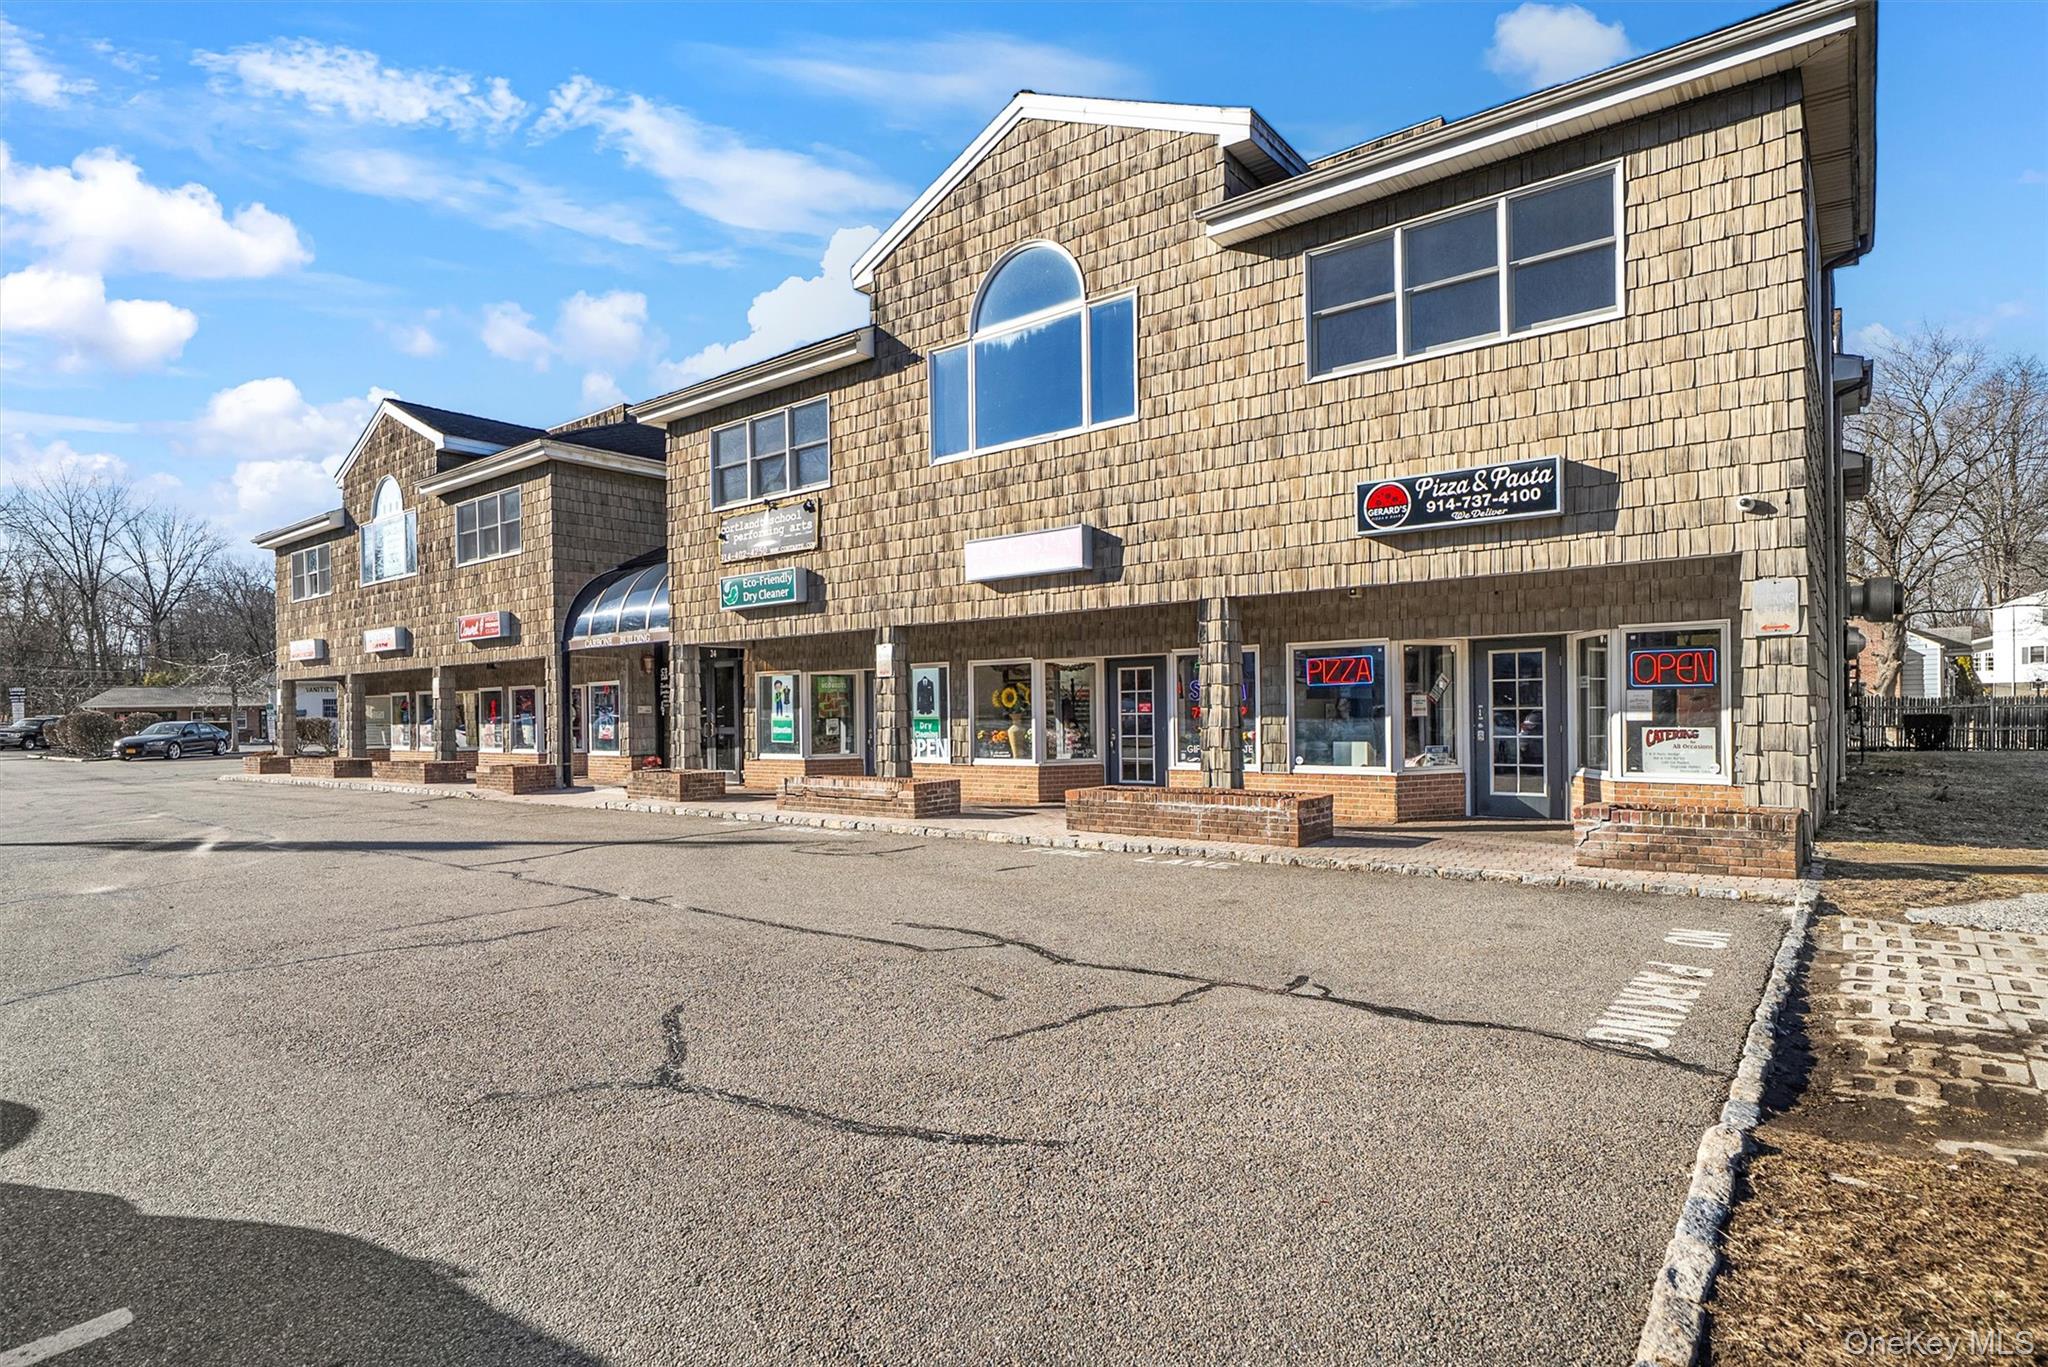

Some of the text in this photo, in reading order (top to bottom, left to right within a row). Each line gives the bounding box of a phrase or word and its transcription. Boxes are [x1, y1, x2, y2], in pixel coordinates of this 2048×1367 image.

[1415, 466, 1554, 499] Pizza & Pasta
[1426, 487, 1541, 513] 914-737-4100
[769, 510, 802, 525] school
[1367, 504, 1408, 517] GERARD'S
[1451, 507, 1509, 522] We Deliver
[790, 519, 813, 532] arts
[743, 572, 793, 589] Eco-Friendly
[743, 587, 790, 603] Dry Cleaner
[620, 633, 651, 645] BUILDING
[1308, 659, 1371, 684] PIZZA
[1634, 652, 1713, 684] OPEN
[919, 722, 933, 731] Dry
[1646, 729, 1699, 748] CATERING
[1585, 961, 1714, 1049] PARKING
